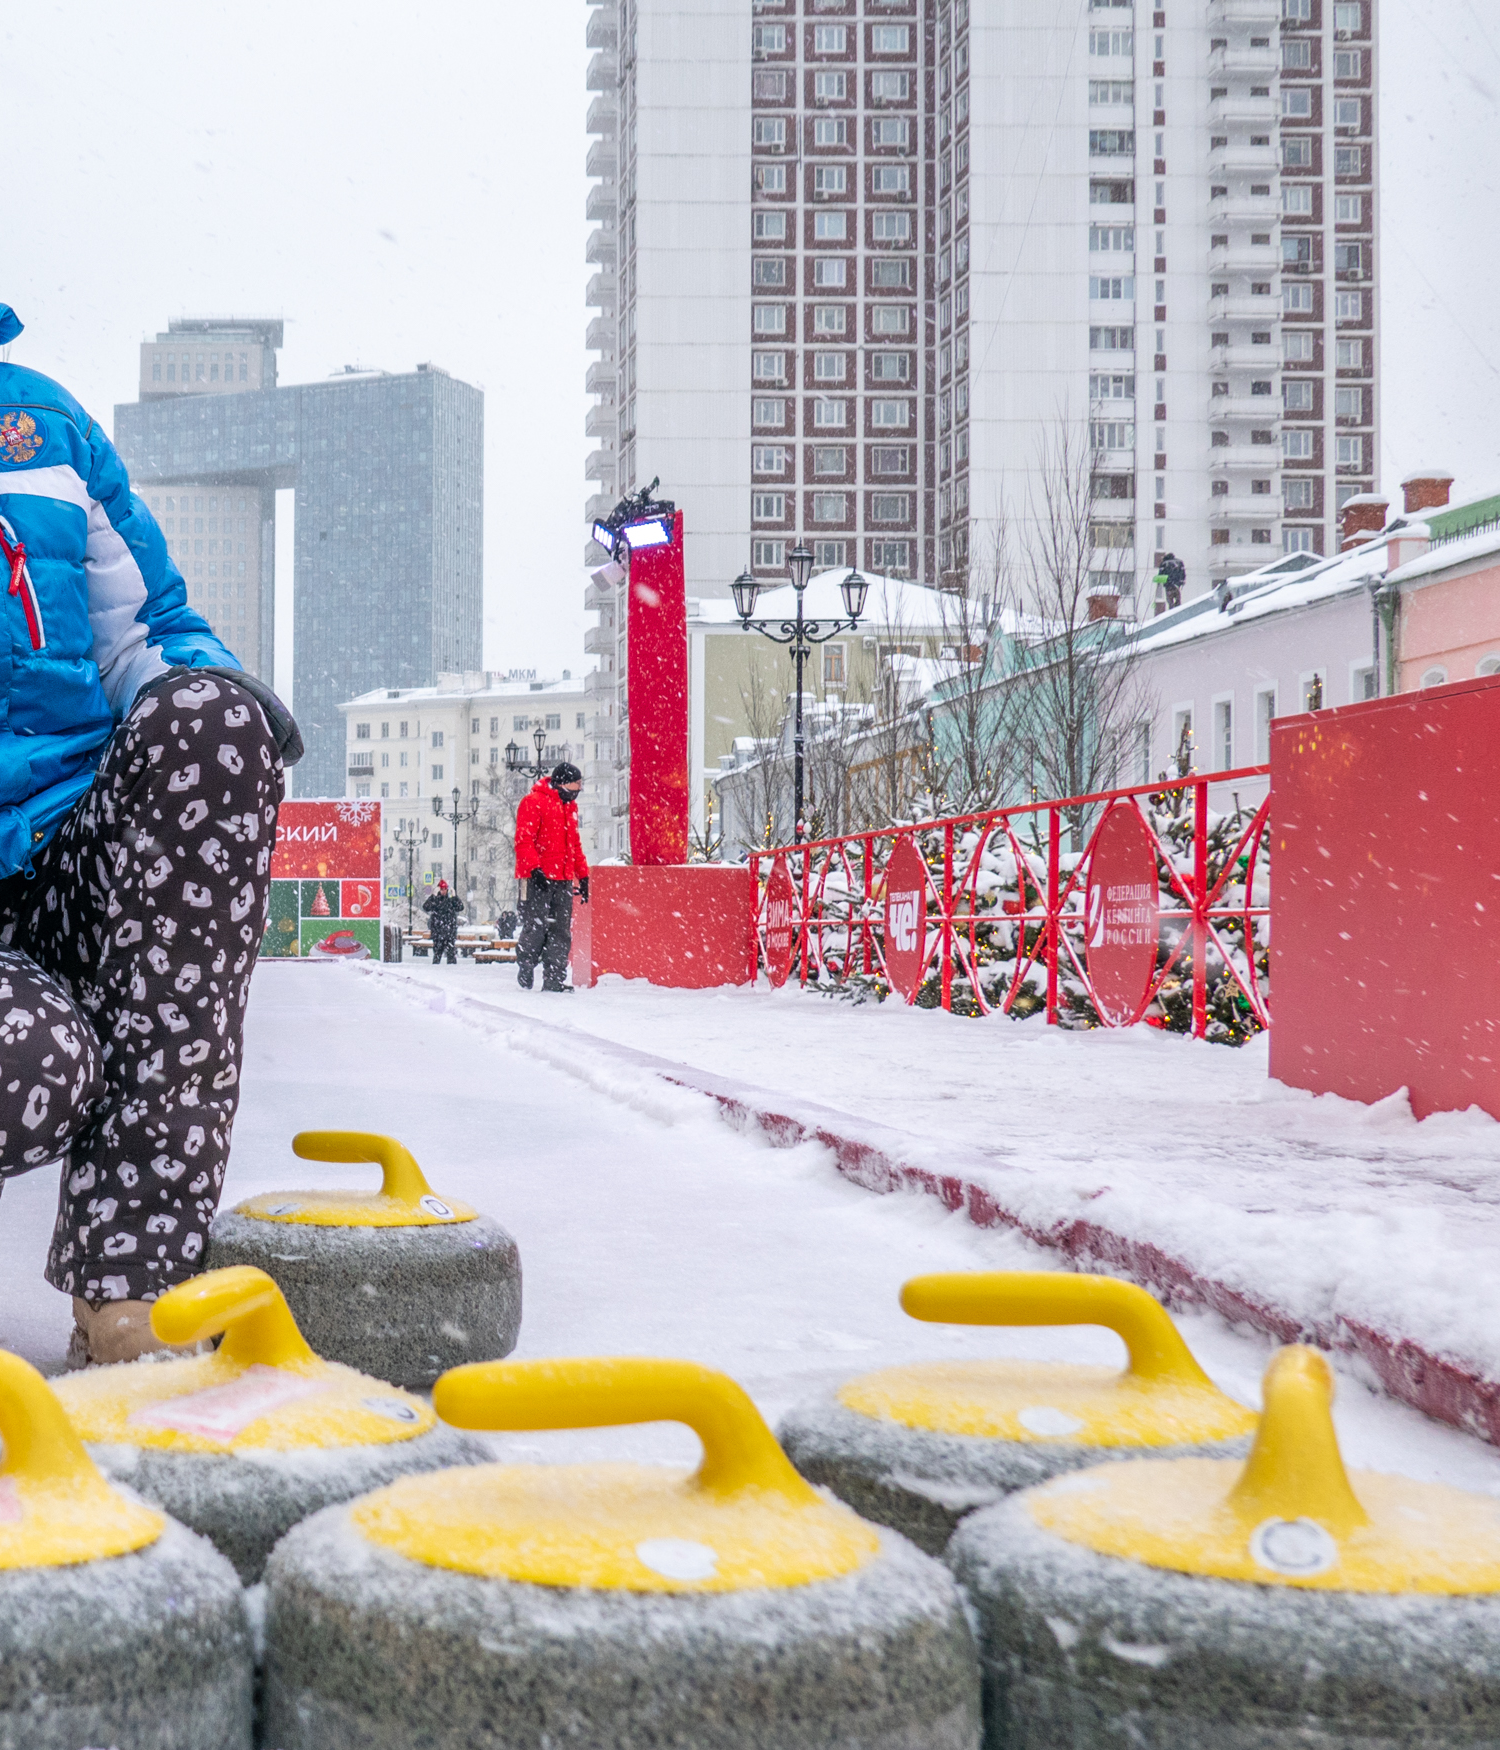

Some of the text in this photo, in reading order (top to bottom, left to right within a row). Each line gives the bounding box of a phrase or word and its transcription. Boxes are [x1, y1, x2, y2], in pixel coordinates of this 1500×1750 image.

[1107, 884, 1151, 902] ФЕДЕРАЦИЯ
[767, 900, 790, 929] ЗИМА
[1107, 928, 1151, 945] РОССИИ
